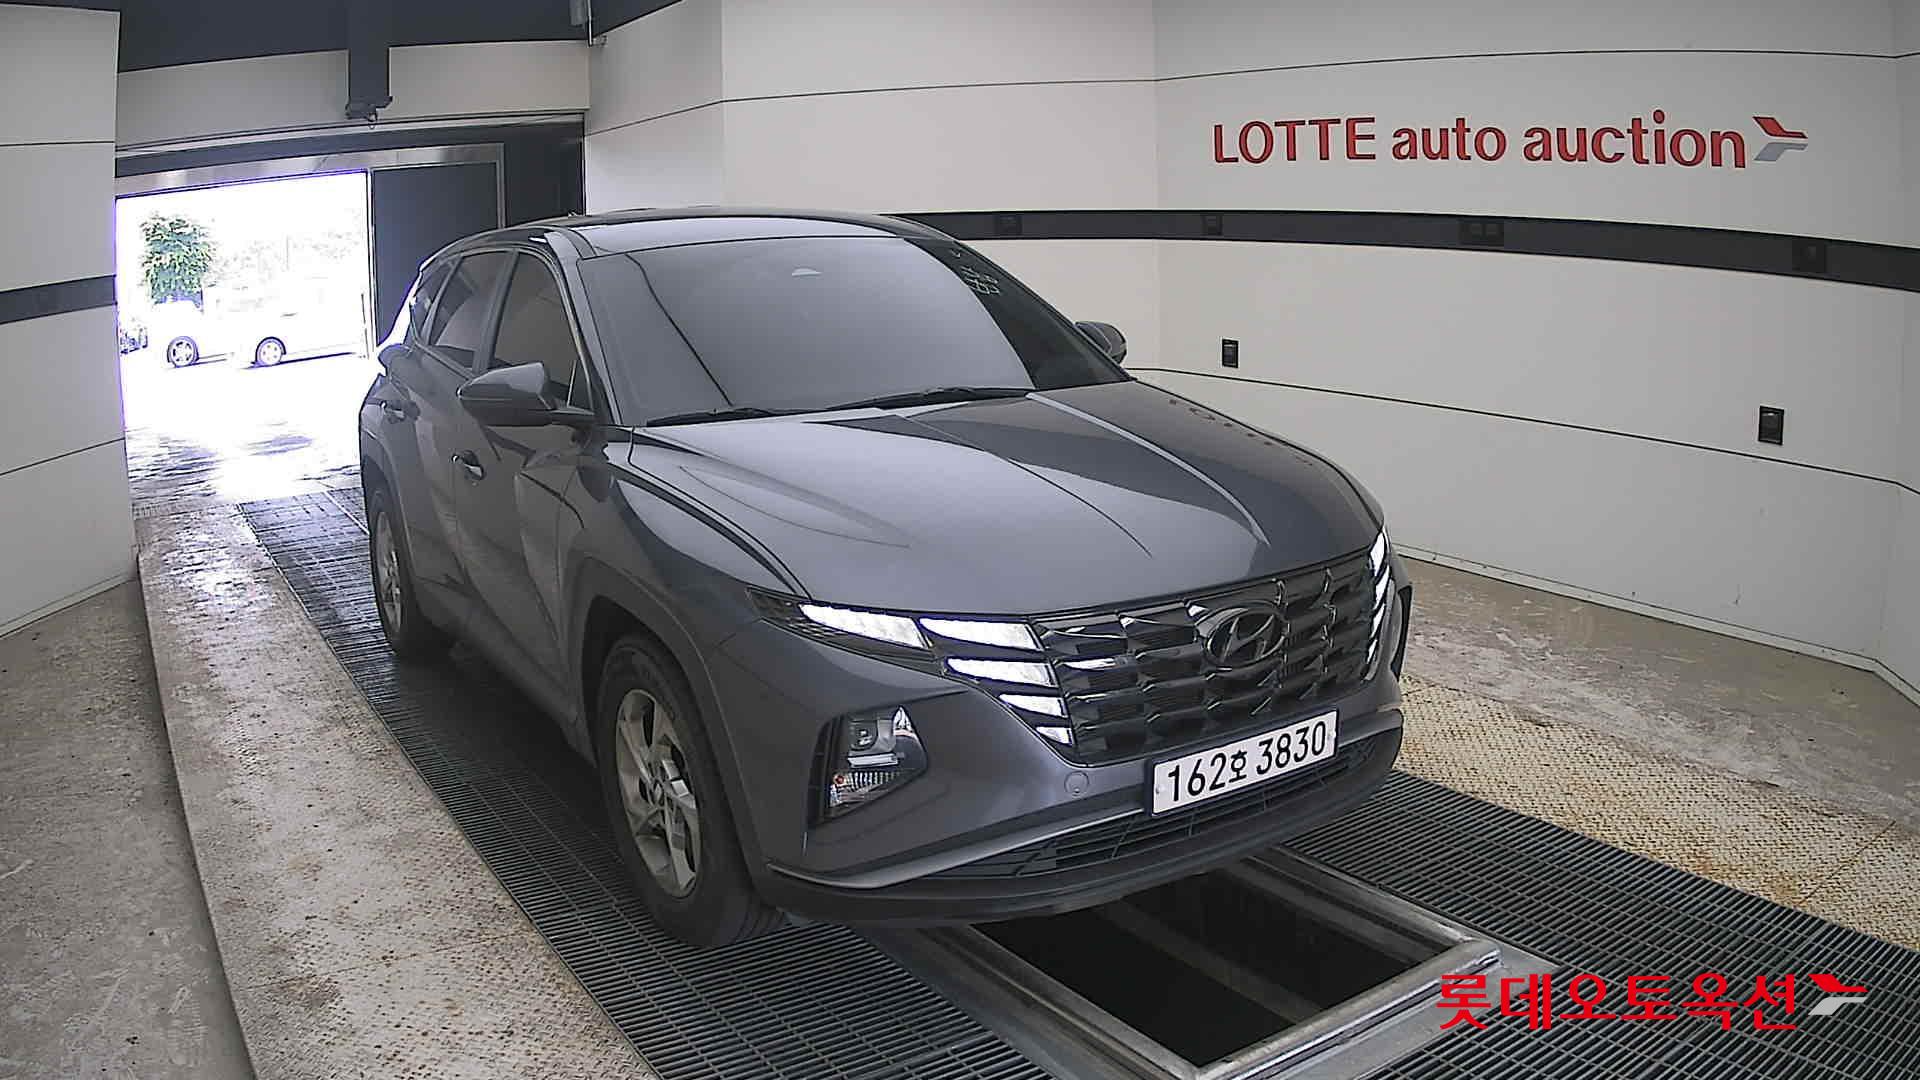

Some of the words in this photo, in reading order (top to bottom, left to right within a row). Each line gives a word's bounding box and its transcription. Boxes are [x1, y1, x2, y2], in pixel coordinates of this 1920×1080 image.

[1213, 117, 1377, 164] LOTTE
[1392, 117, 1507, 162] auto
[1523, 109, 1746, 168] auction
[1168, 750, 1247, 802] 162호
[1256, 721, 1326, 775] 3830
